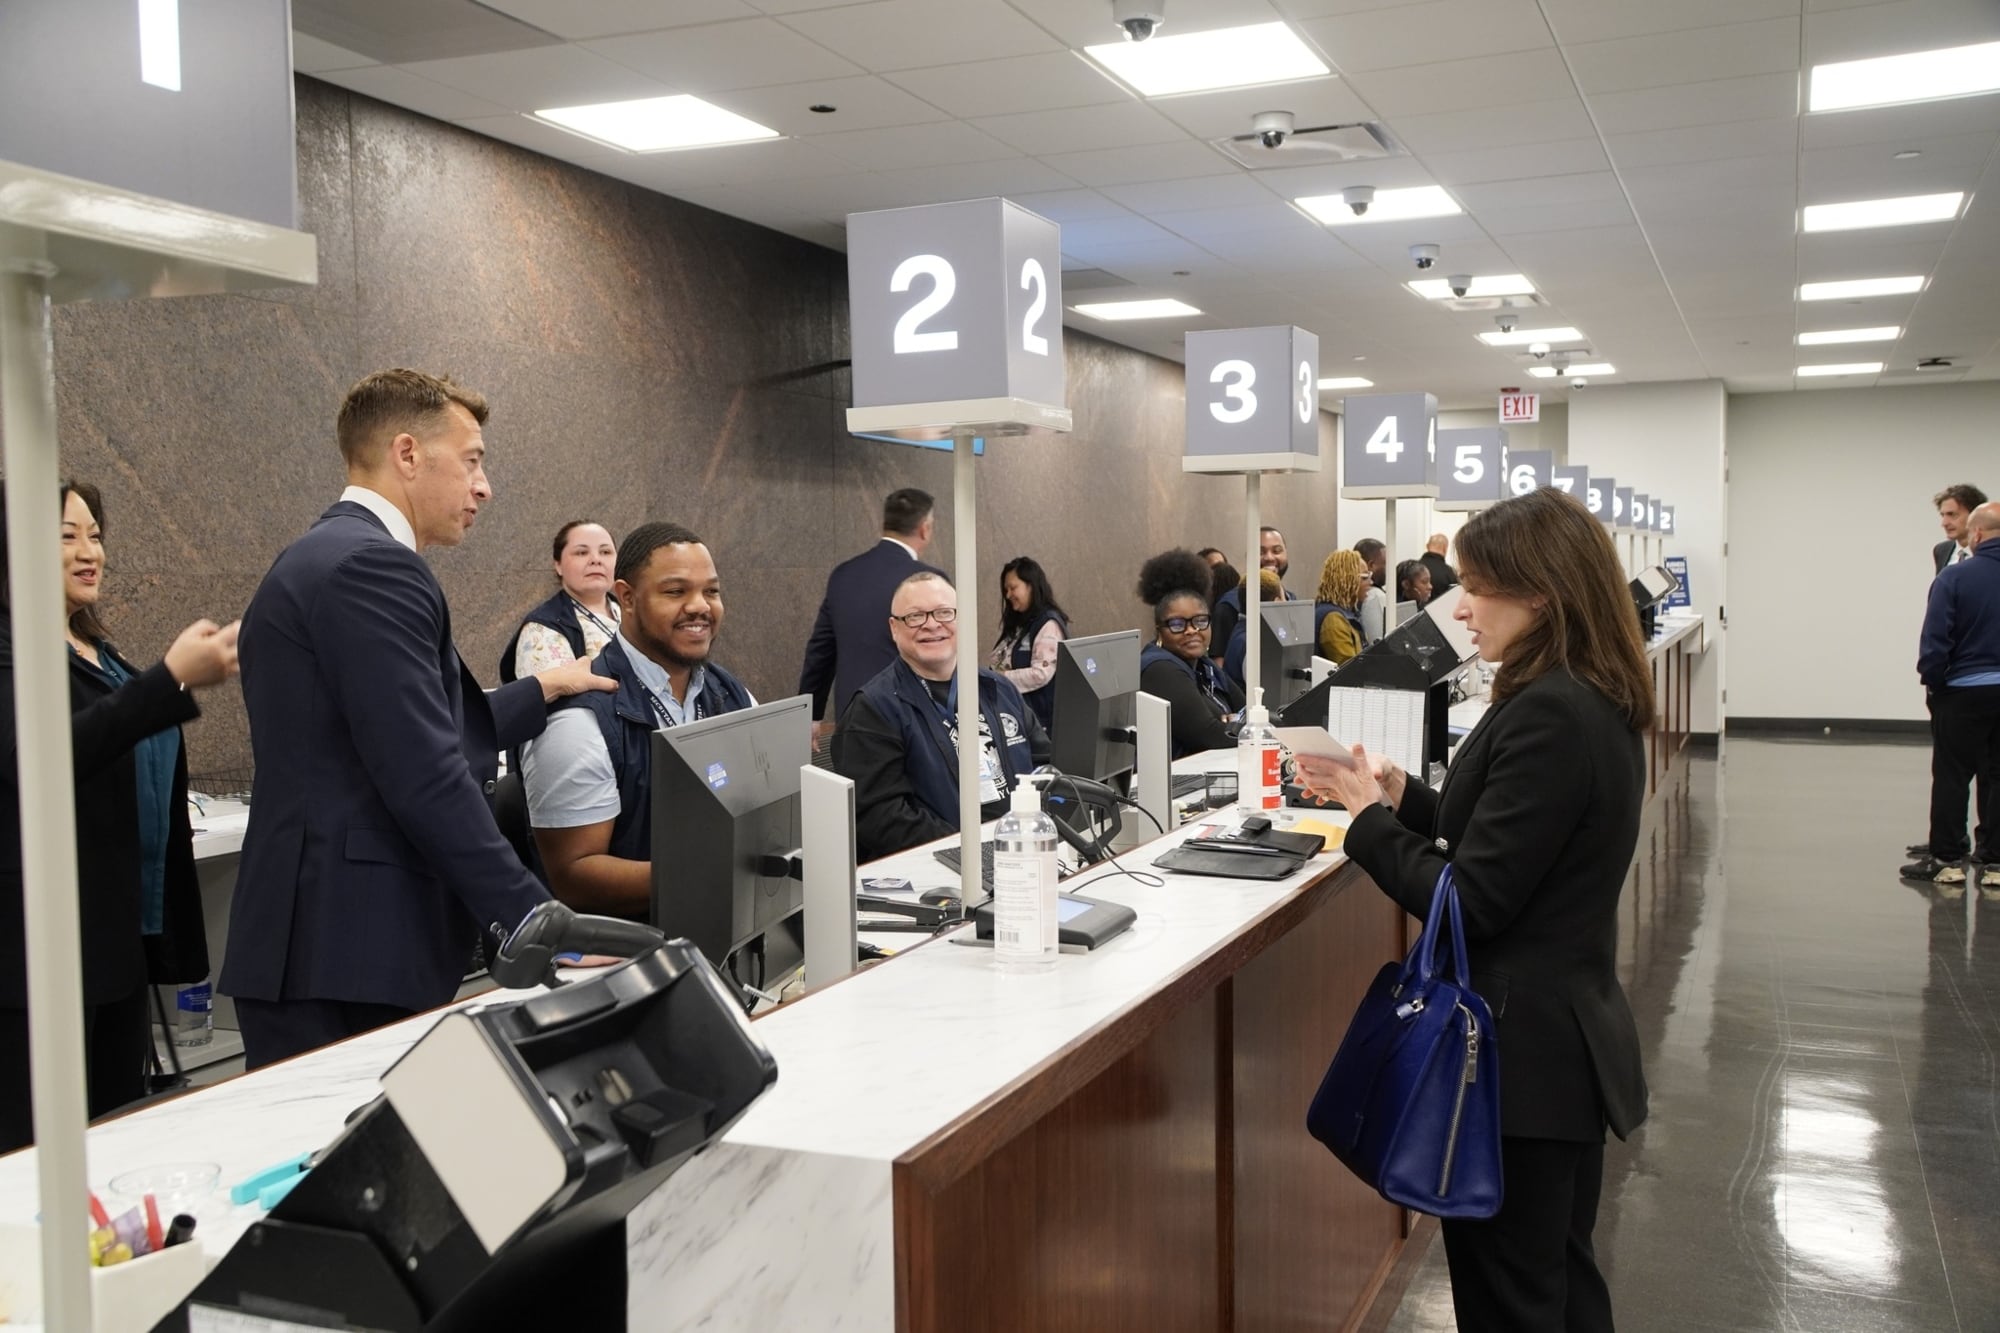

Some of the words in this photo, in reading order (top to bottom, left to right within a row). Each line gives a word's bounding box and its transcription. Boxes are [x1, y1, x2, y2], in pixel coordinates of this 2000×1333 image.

[890, 254, 958, 354] 2
[1020, 258, 1049, 356] 2
[1209, 359, 1257, 424] 3
[1299, 360, 1312, 424] 3
[1503, 396, 1535, 416] EXIT
[1366, 415, 1404, 463] 4
[1453, 445, 1484, 484] 5
[1510, 464, 1536, 497] 6
[1660, 511, 1671, 530] 2
